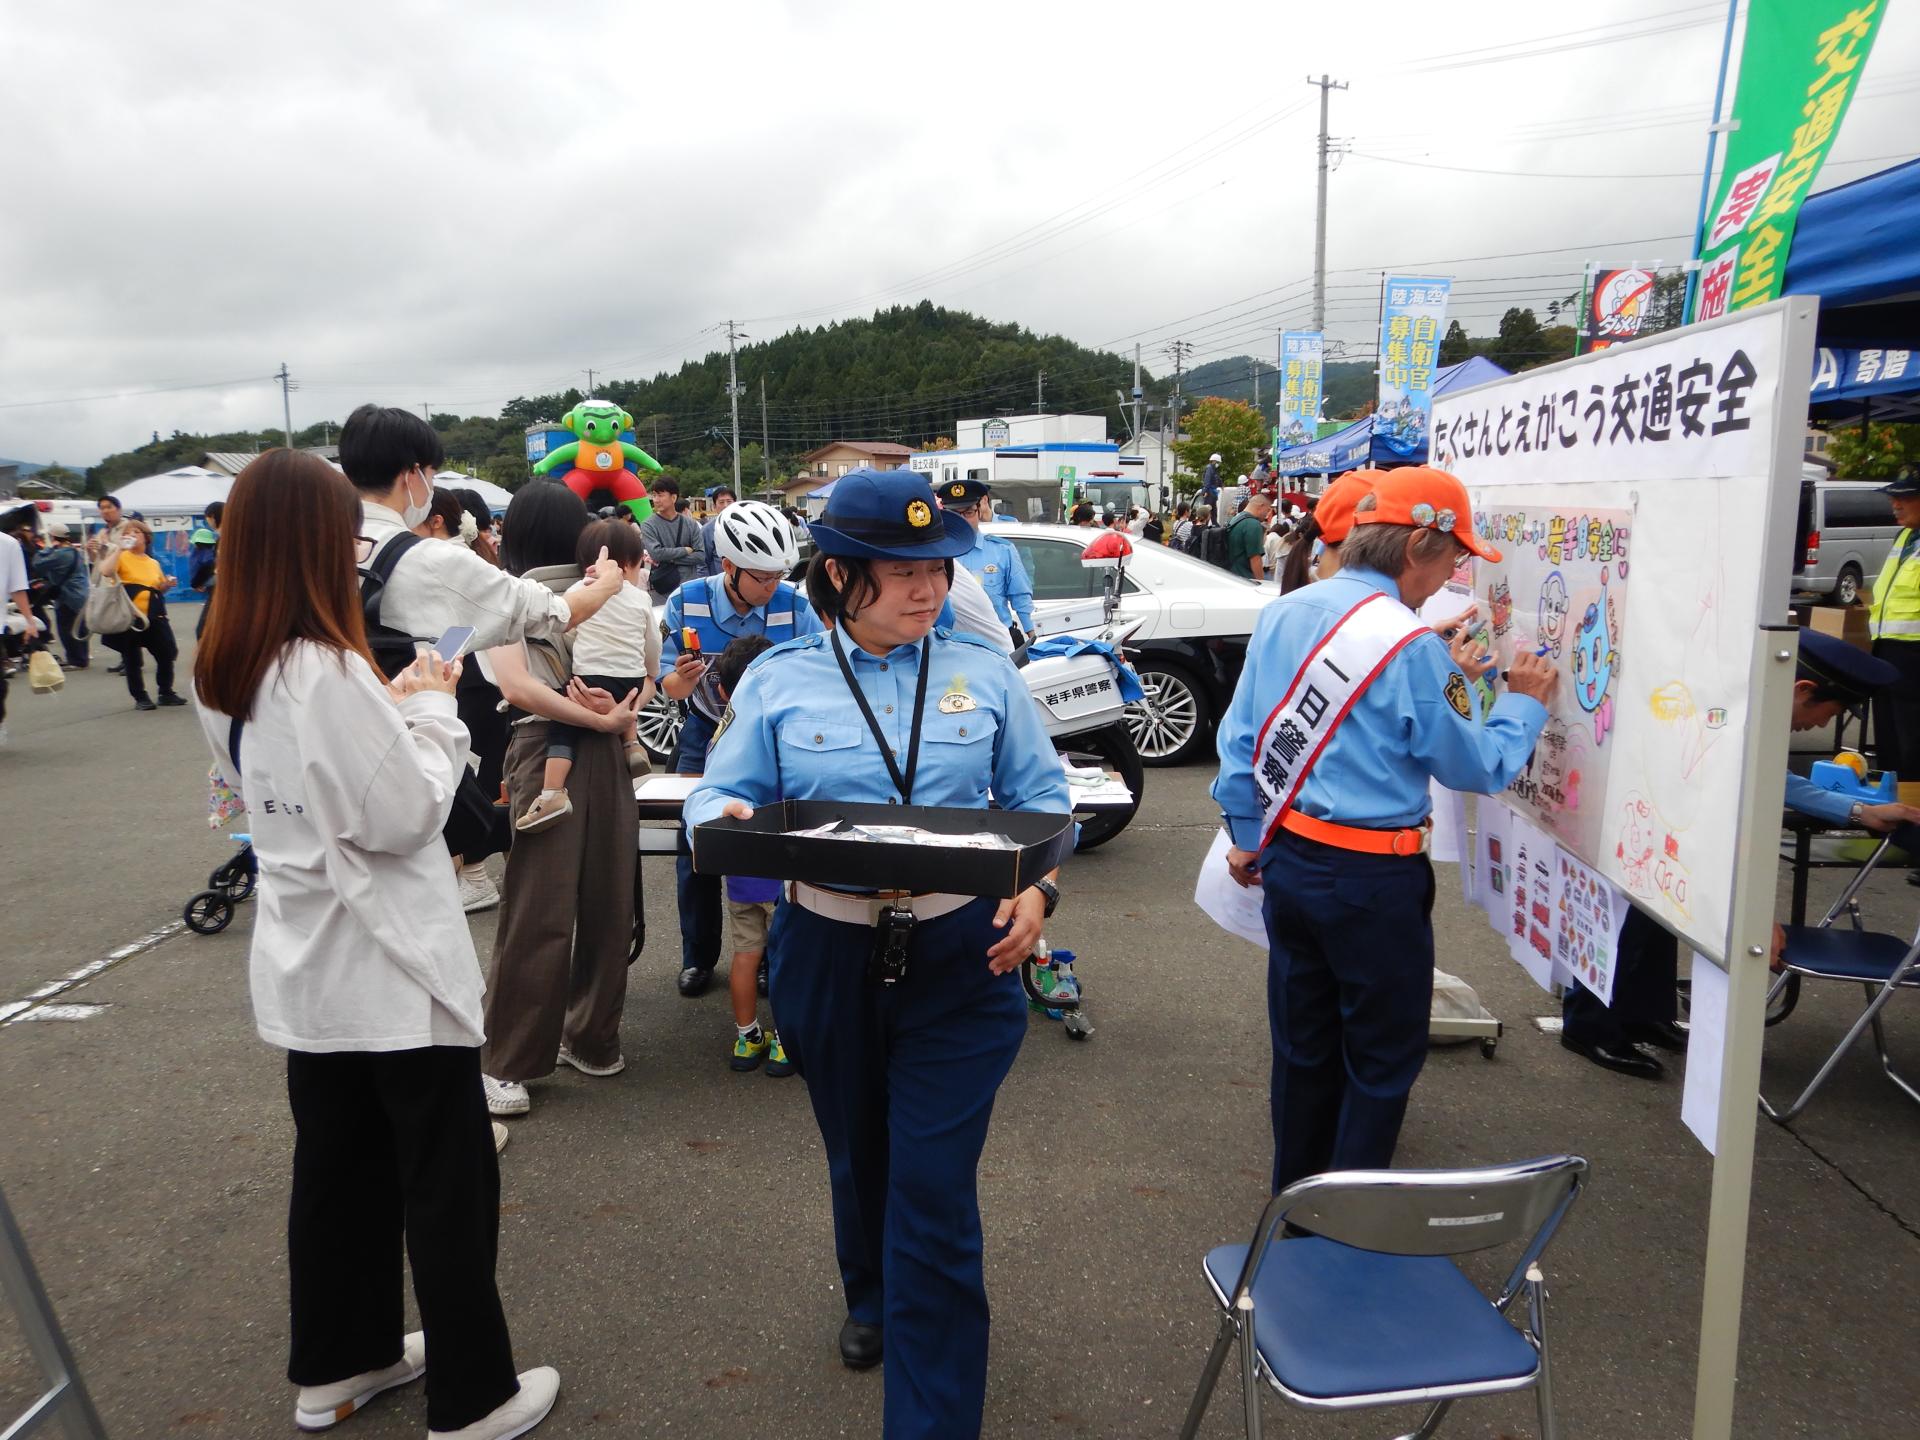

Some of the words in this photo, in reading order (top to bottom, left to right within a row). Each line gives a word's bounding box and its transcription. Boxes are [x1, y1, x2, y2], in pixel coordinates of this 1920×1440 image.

[1731, 0, 1878, 312] 交通安全
[1391, 287, 1443, 305] 陸海空
[1386, 315, 1412, 389] 募集中
[1410, 316, 1437, 391] 自衛官
[1433, 349, 1758, 462] たくさんとえがこう交通安全
[1045, 679, 1113, 706] 岩手県警察
